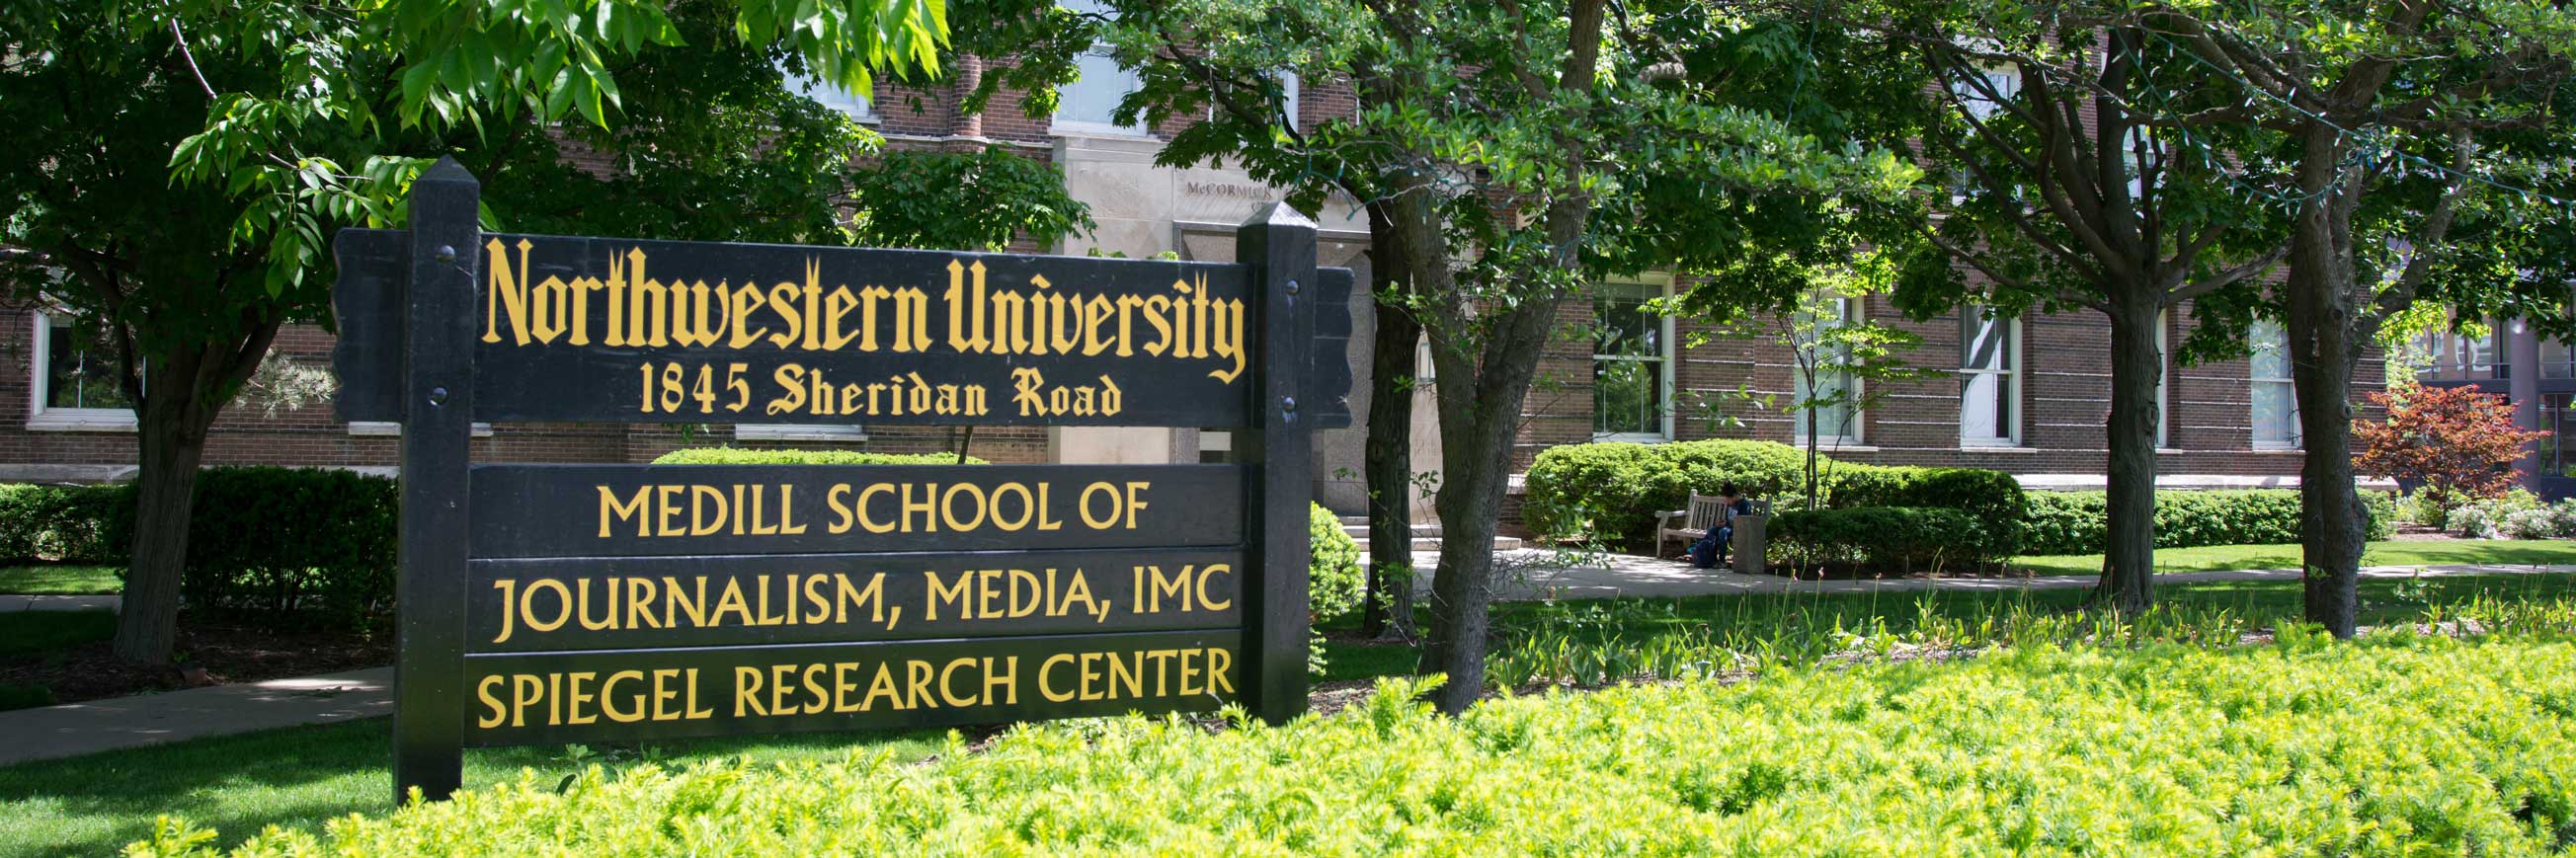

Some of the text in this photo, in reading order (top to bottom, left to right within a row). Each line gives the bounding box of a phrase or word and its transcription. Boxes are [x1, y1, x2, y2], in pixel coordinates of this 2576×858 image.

[482, 237, 1247, 385] Northwestern University
[641, 362, 1123, 417] 1845 Sheridan Road
[597, 481, 1151, 538] MEDILL SCHOOL OF
[493, 563, 1232, 644] JOURNALISM, MEDIA, IMC
[477, 647, 1235, 729] SPIEGEL RESEARCH CENTER
